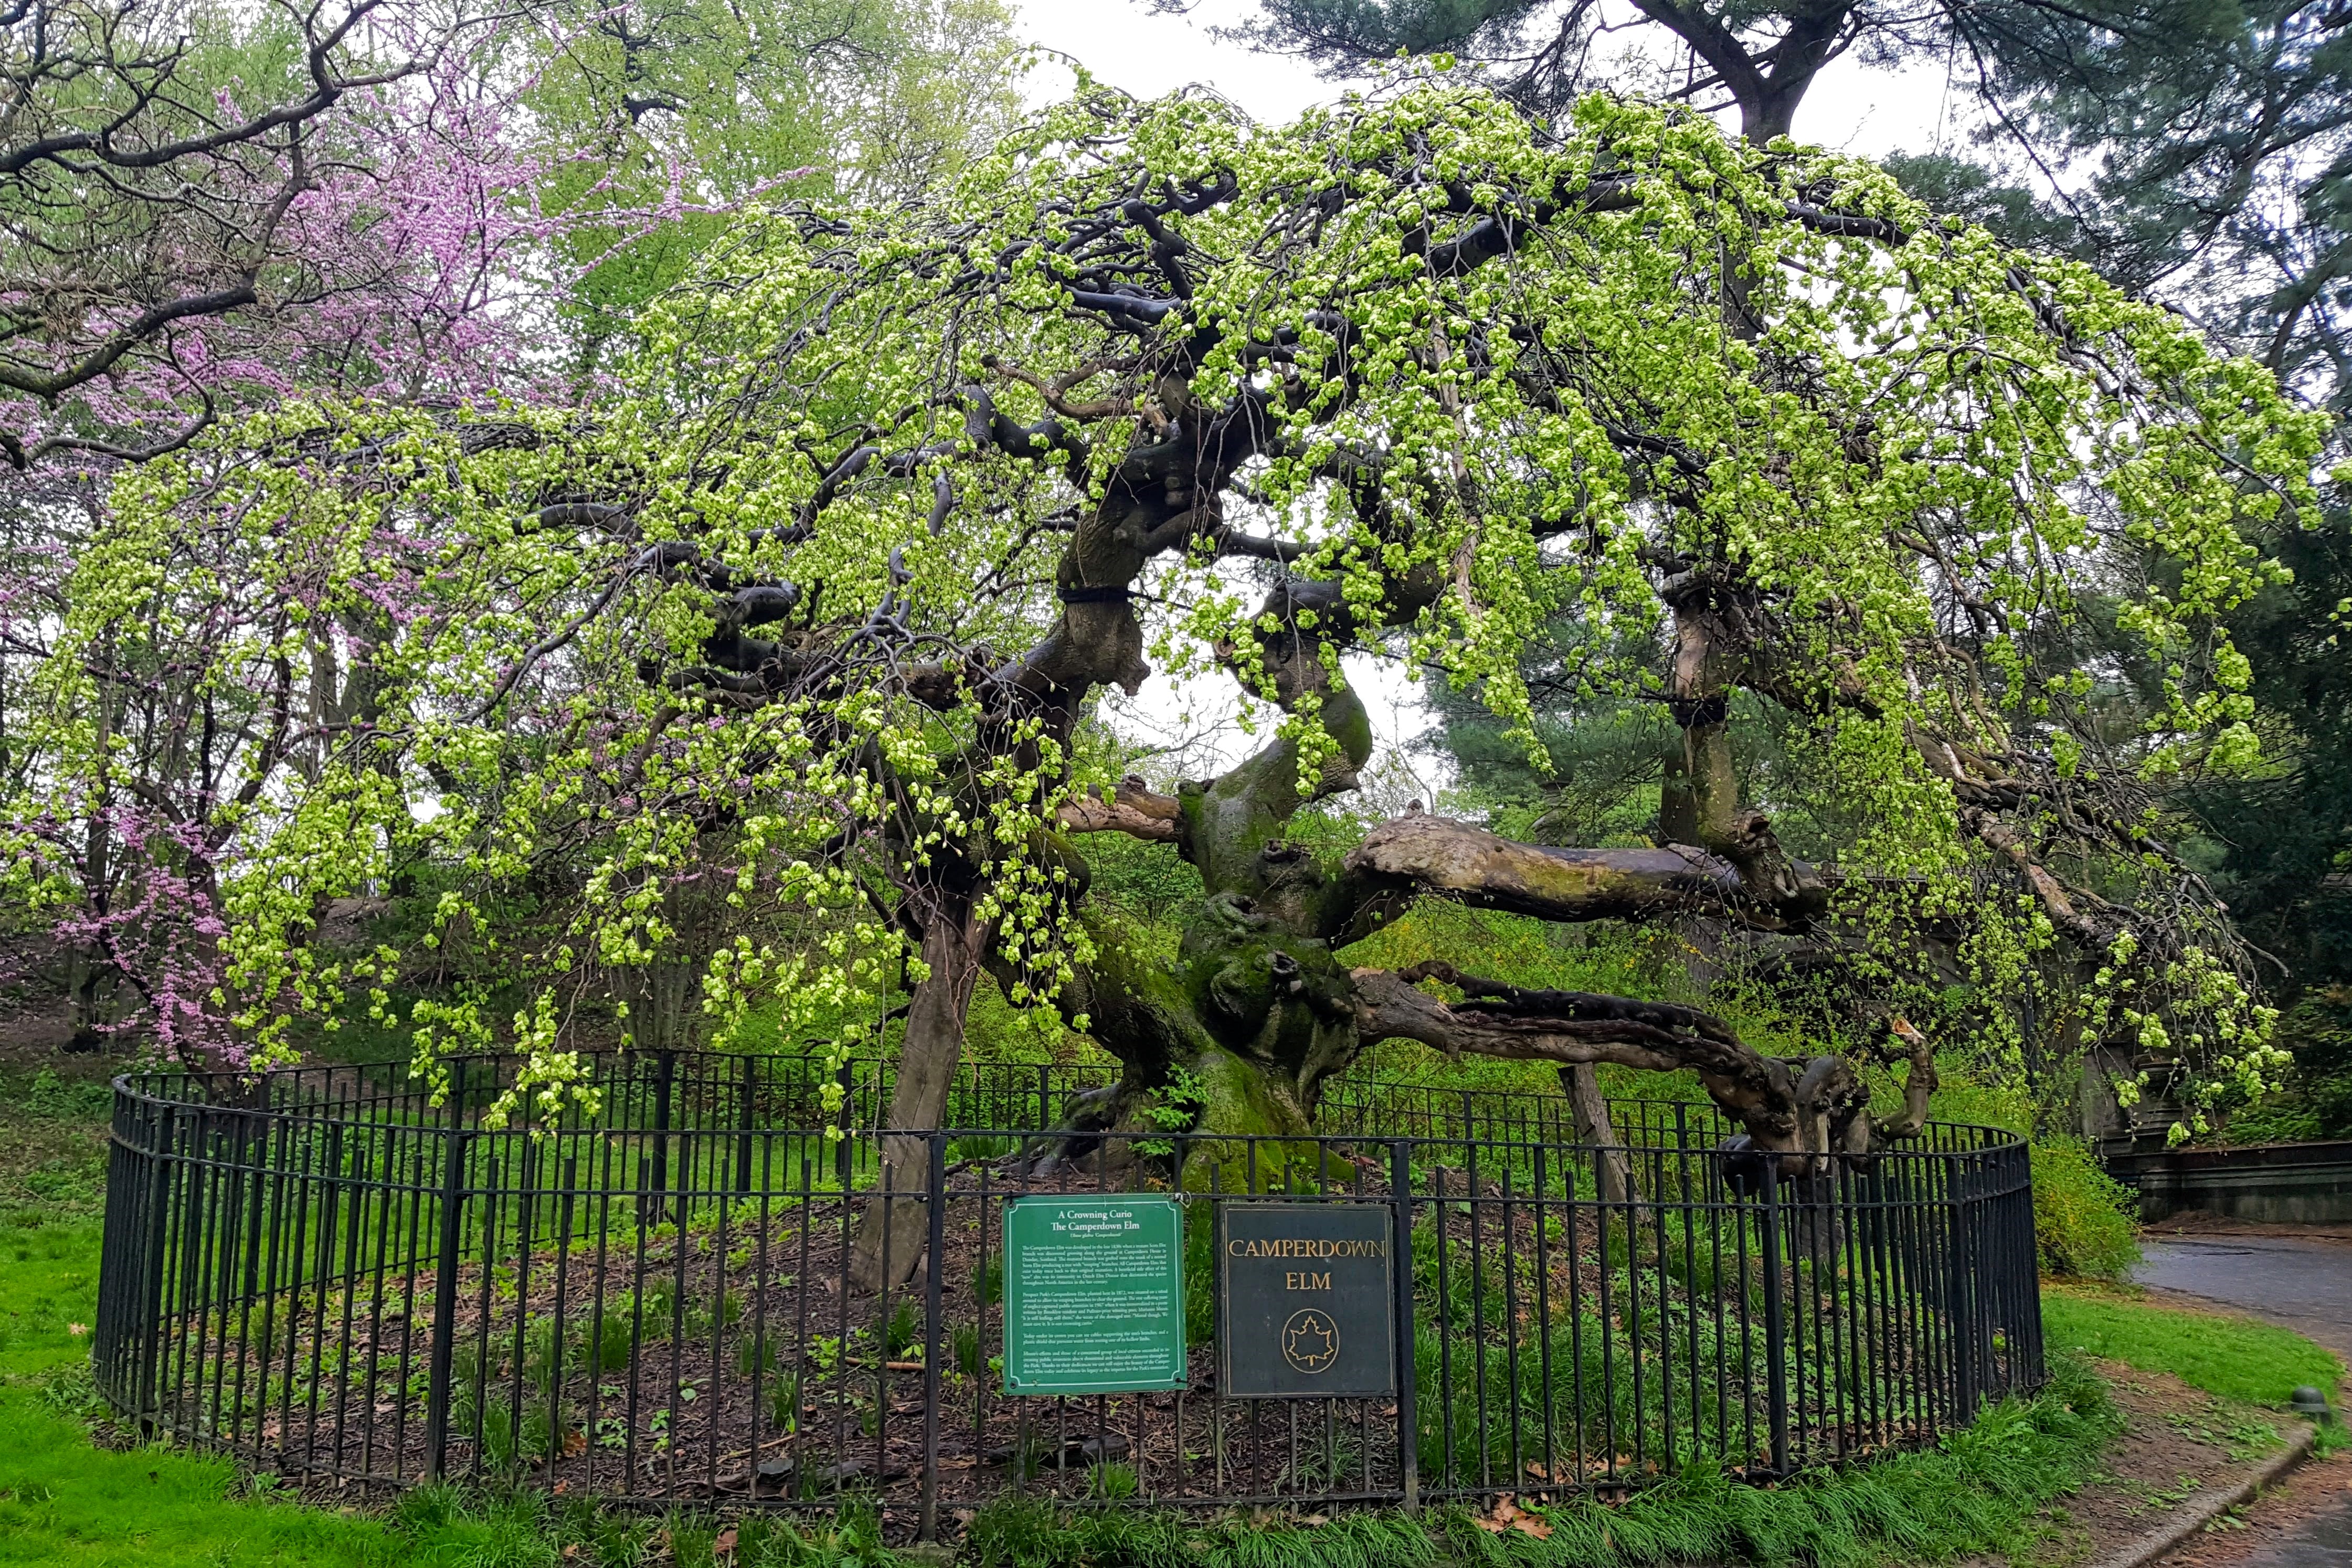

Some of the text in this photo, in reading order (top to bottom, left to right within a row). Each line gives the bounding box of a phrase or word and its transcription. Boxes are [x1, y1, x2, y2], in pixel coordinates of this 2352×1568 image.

[1067, 1210, 1108, 1221] Crowning
[1051, 1223, 1066, 1231] The
[1068, 1222, 1121, 1232] Camperdown
[1228, 1239, 1385, 1257] CAMPERDOWN
[1286, 1272, 1331, 1291] ELM
